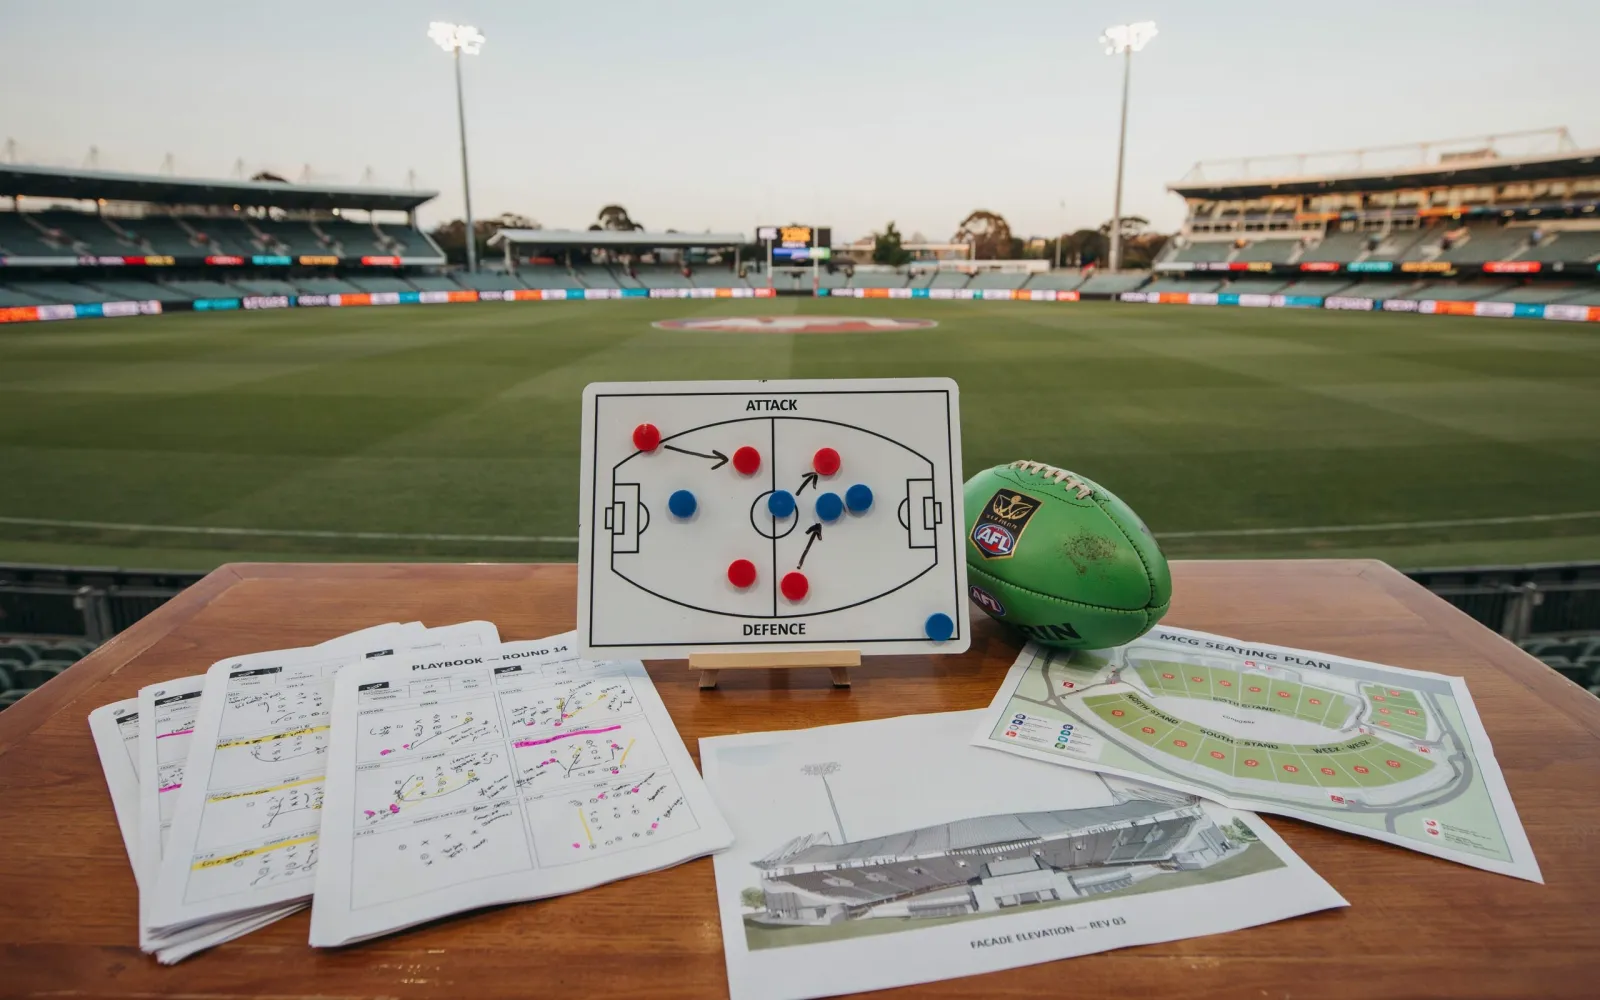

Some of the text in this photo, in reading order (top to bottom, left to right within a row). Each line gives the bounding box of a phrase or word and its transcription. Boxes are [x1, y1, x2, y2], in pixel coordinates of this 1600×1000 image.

[746, 399, 798, 411] ATTACK
[976, 528, 1009, 552] AFL
[972, 589, 1002, 613] AFL
[742, 623, 806, 636] DEFENCE
[412, 657, 483, 671] PLAYBOOK
[502, 648, 550, 661] ROUND
[553, 645, 569, 653] 14
[1159, 633, 1332, 670] MCG SEATING PLAN
[1244, 741, 1280, 750] STAND
[969, 935, 1014, 949] FACADE
[1015, 925, 1075, 943] ELEVATION
[1089, 919, 1114, 929] REV
[1112, 916, 1127, 926] 03
